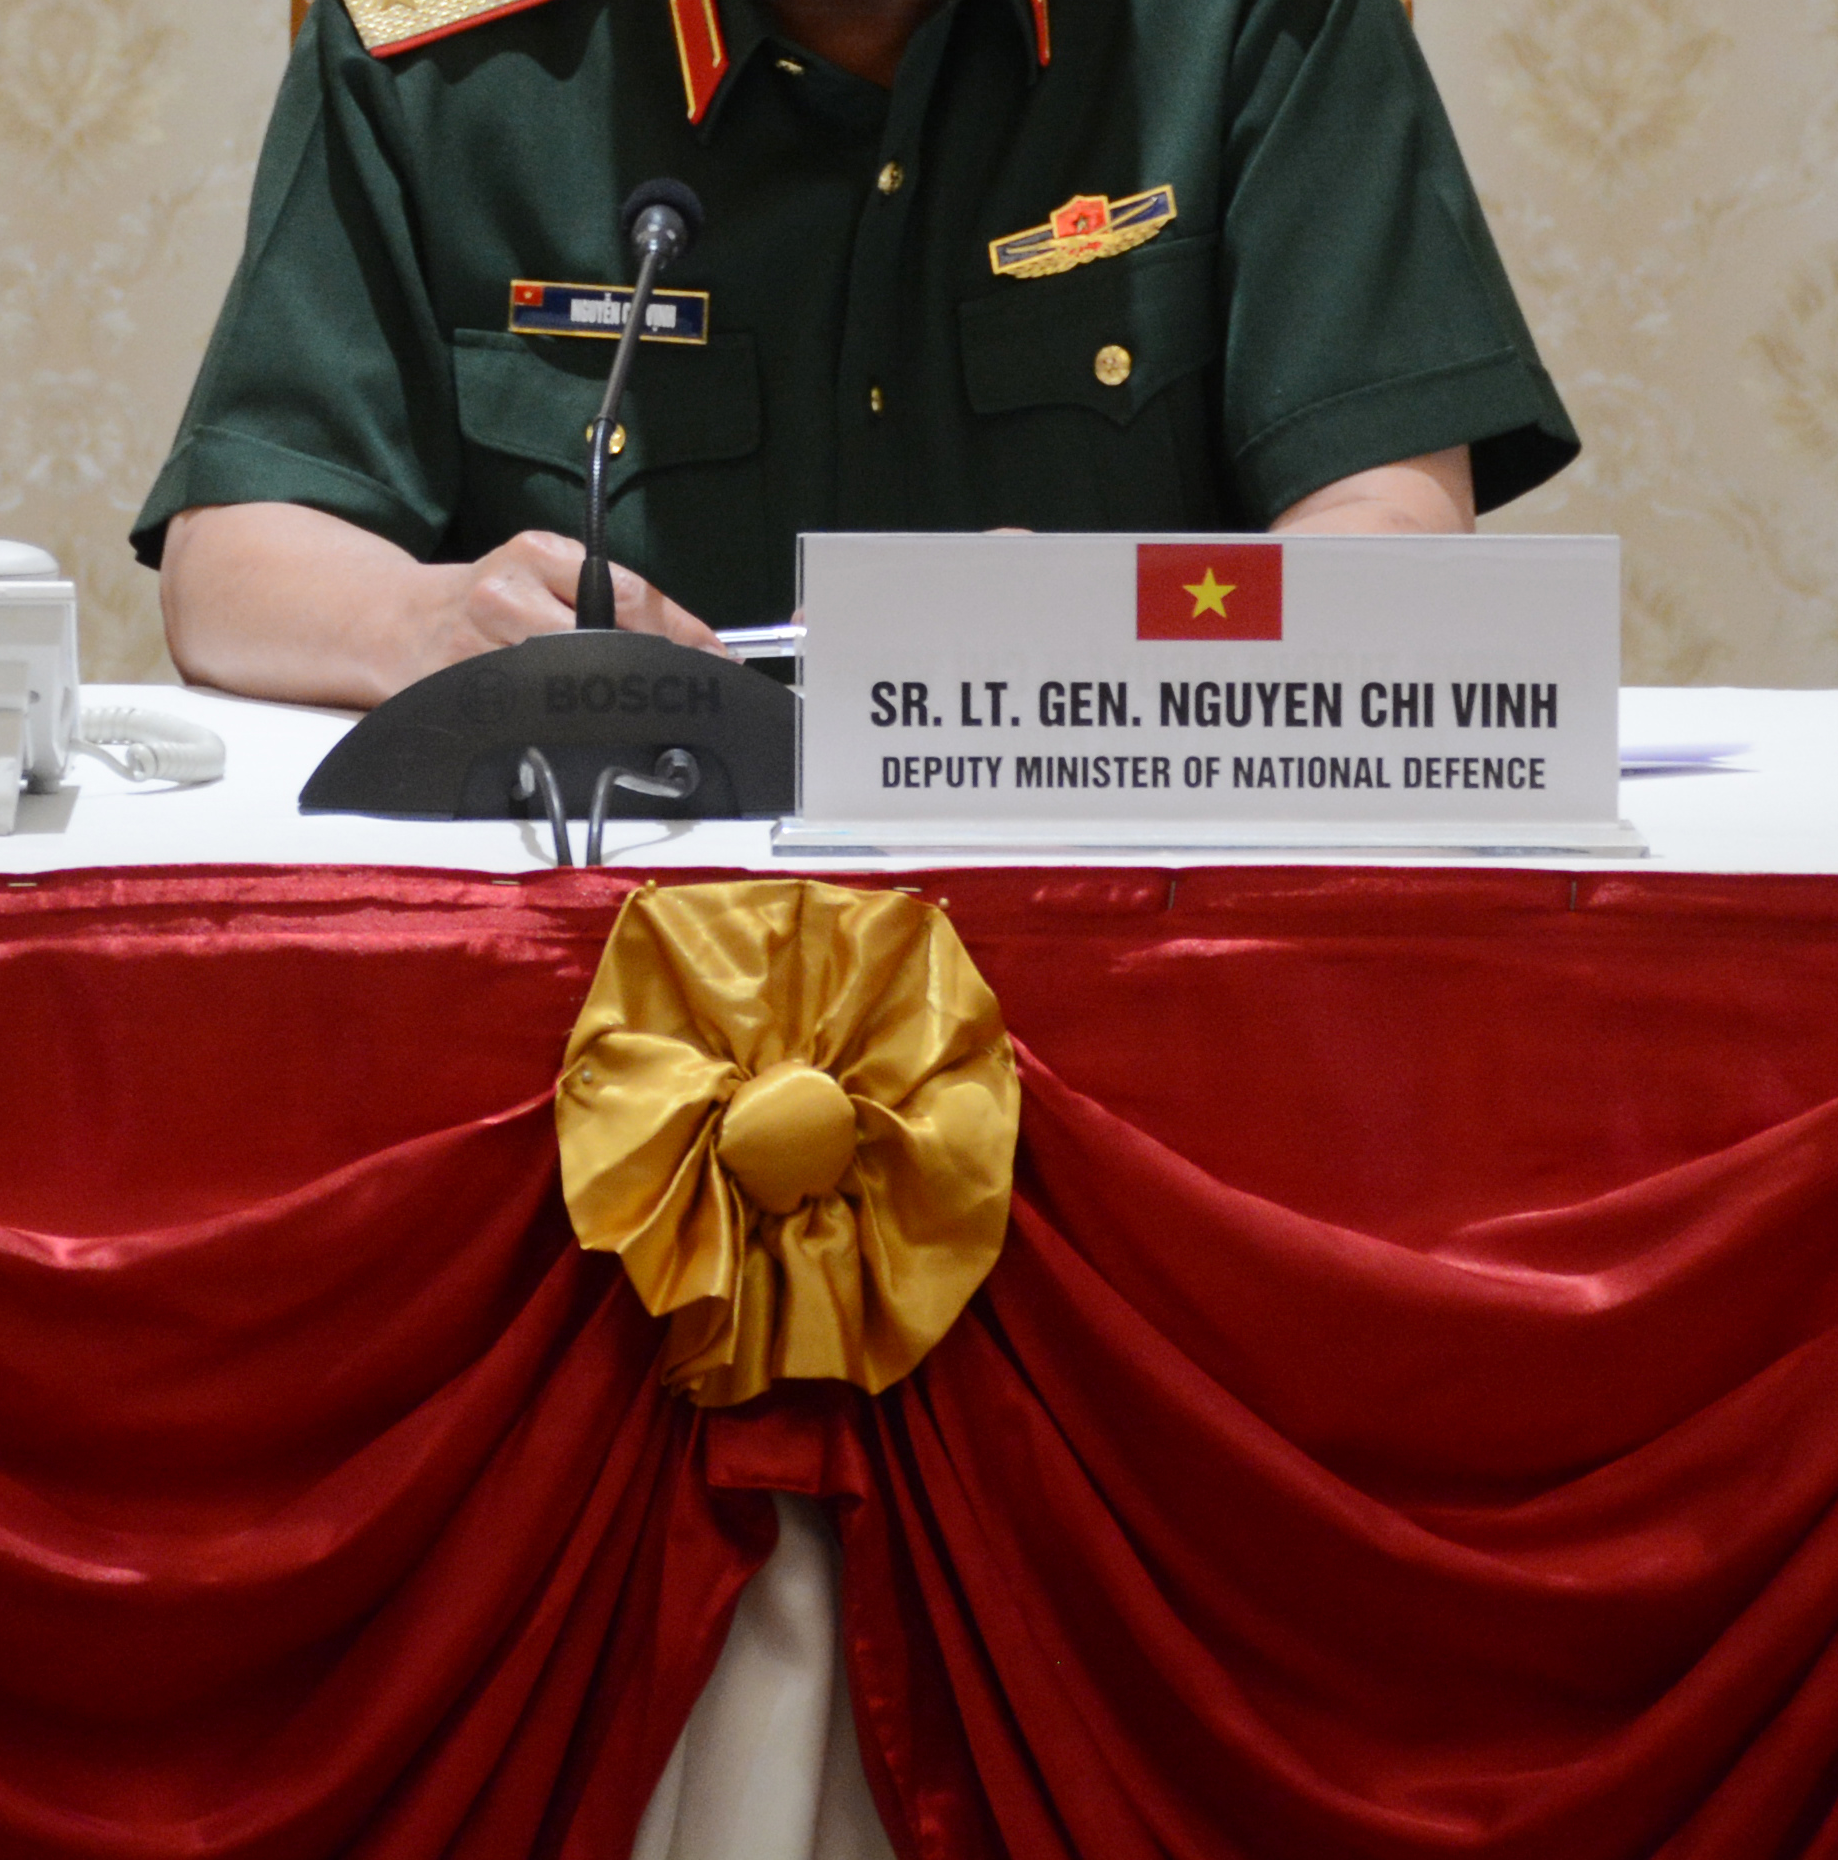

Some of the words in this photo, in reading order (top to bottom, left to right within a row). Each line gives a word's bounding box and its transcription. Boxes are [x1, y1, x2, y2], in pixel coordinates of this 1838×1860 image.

[545, 673, 722, 716] BOSCH
[869, 680, 943, 728] SR.
[960, 680, 1021, 728] LT.
[1038, 680, 1142, 728] GEN.
[1159, 680, 1343, 729] NGUYEN
[1360, 680, 1435, 729] CHI
[1451, 681, 1558, 729] VINH
[881, 755, 1003, 789] DEPUTY
[1015, 755, 1171, 789] MINISTER
[1183, 755, 1221, 789] OF
[1232, 755, 1392, 789] NATIONAL
[1403, 756, 1546, 790] DEFENCE
